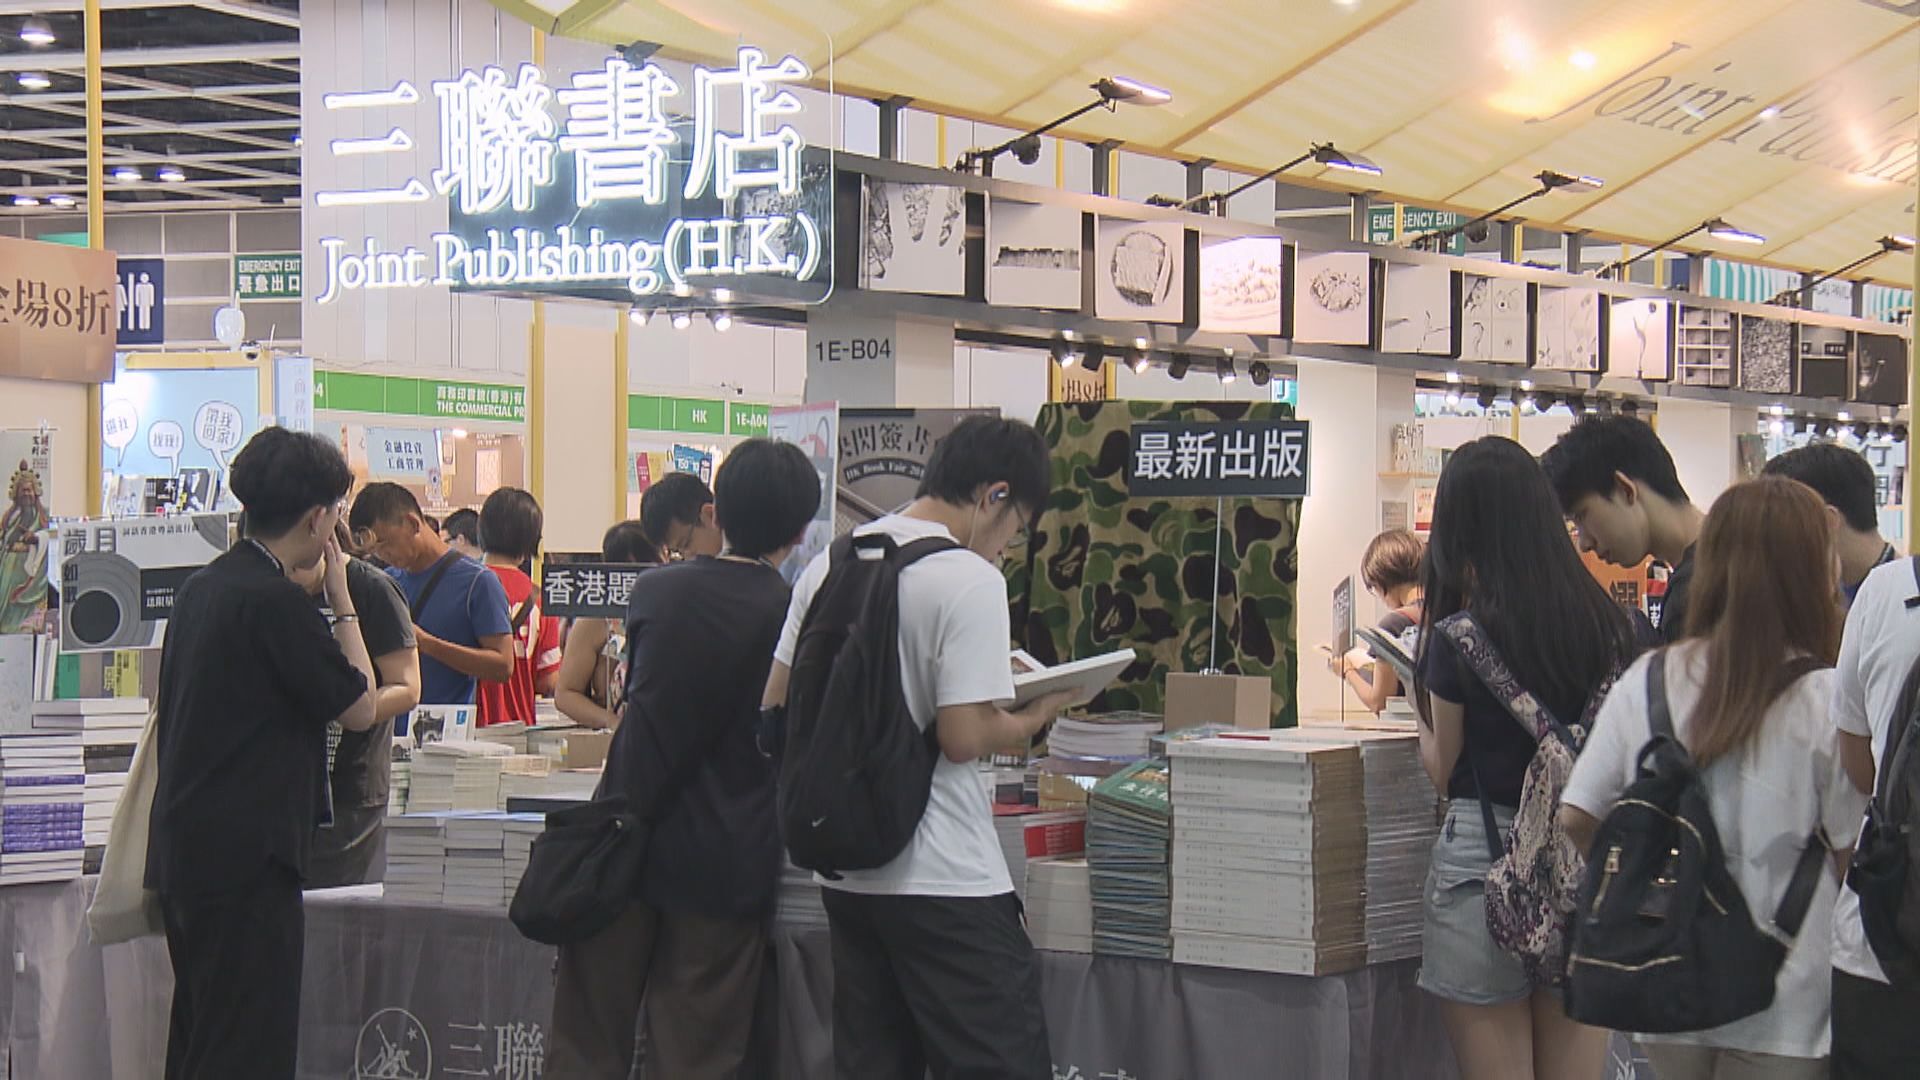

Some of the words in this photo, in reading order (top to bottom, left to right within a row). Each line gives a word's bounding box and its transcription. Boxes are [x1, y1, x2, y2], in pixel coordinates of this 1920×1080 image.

[315, 46, 813, 215] 三聯書店
[316, 236, 429, 304] Joint
[432, 225, 662, 294] Publishing
[815, 338, 891, 362] 1E-B04
[437, 401, 454, 413] THE
[456, 402, 511, 417] COMMERCIAL
[692, 409, 707, 423] HK
[736, 412, 768, 427] 1E-A04
[1134, 429, 1303, 480] 最新出版
[863, 461, 885, 475] Book
[888, 460, 907, 473] Fair
[443, 1021, 545, 1080] 三聯
